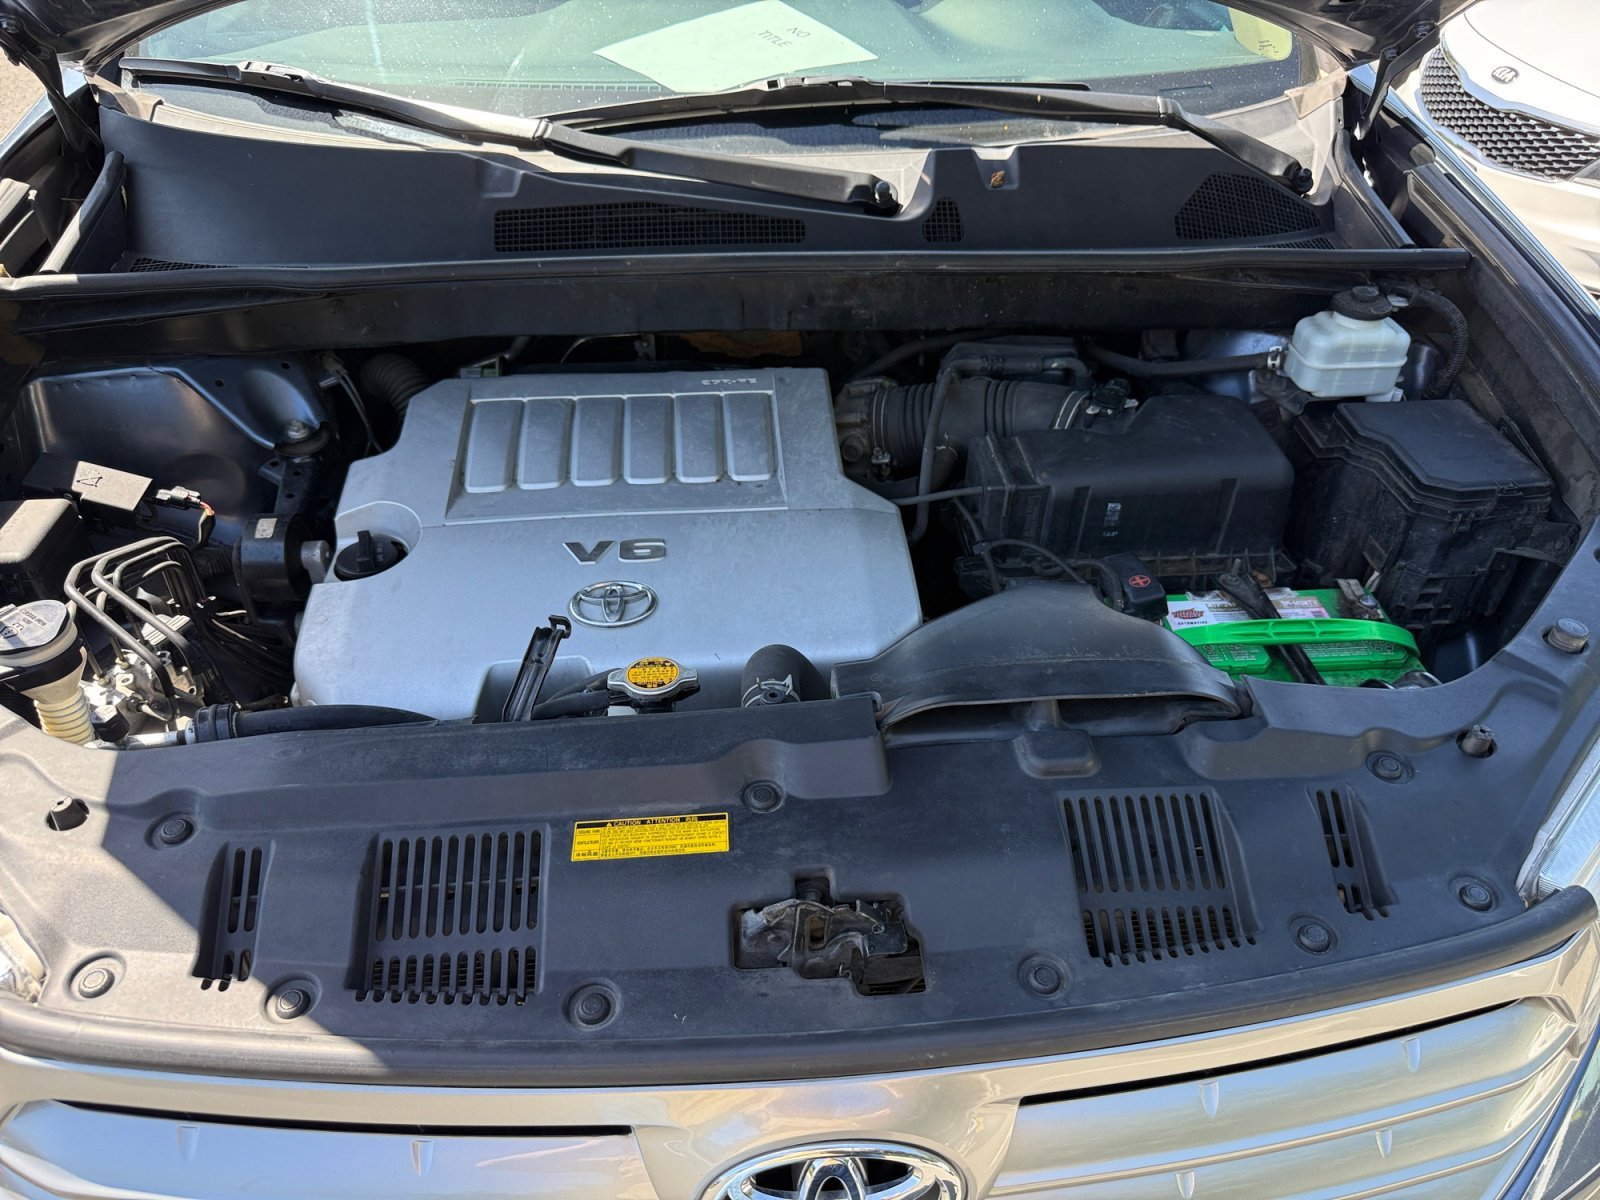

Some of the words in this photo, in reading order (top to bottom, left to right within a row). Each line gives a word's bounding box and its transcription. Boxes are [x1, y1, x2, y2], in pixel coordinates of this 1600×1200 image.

[758, 30, 793, 48] TITLE
[786, 26, 811, 38] NO
[562, 539, 666, 565] V6
[613, 819, 641, 827] CAUTION
[645, 816, 680, 825] ATTENTION
